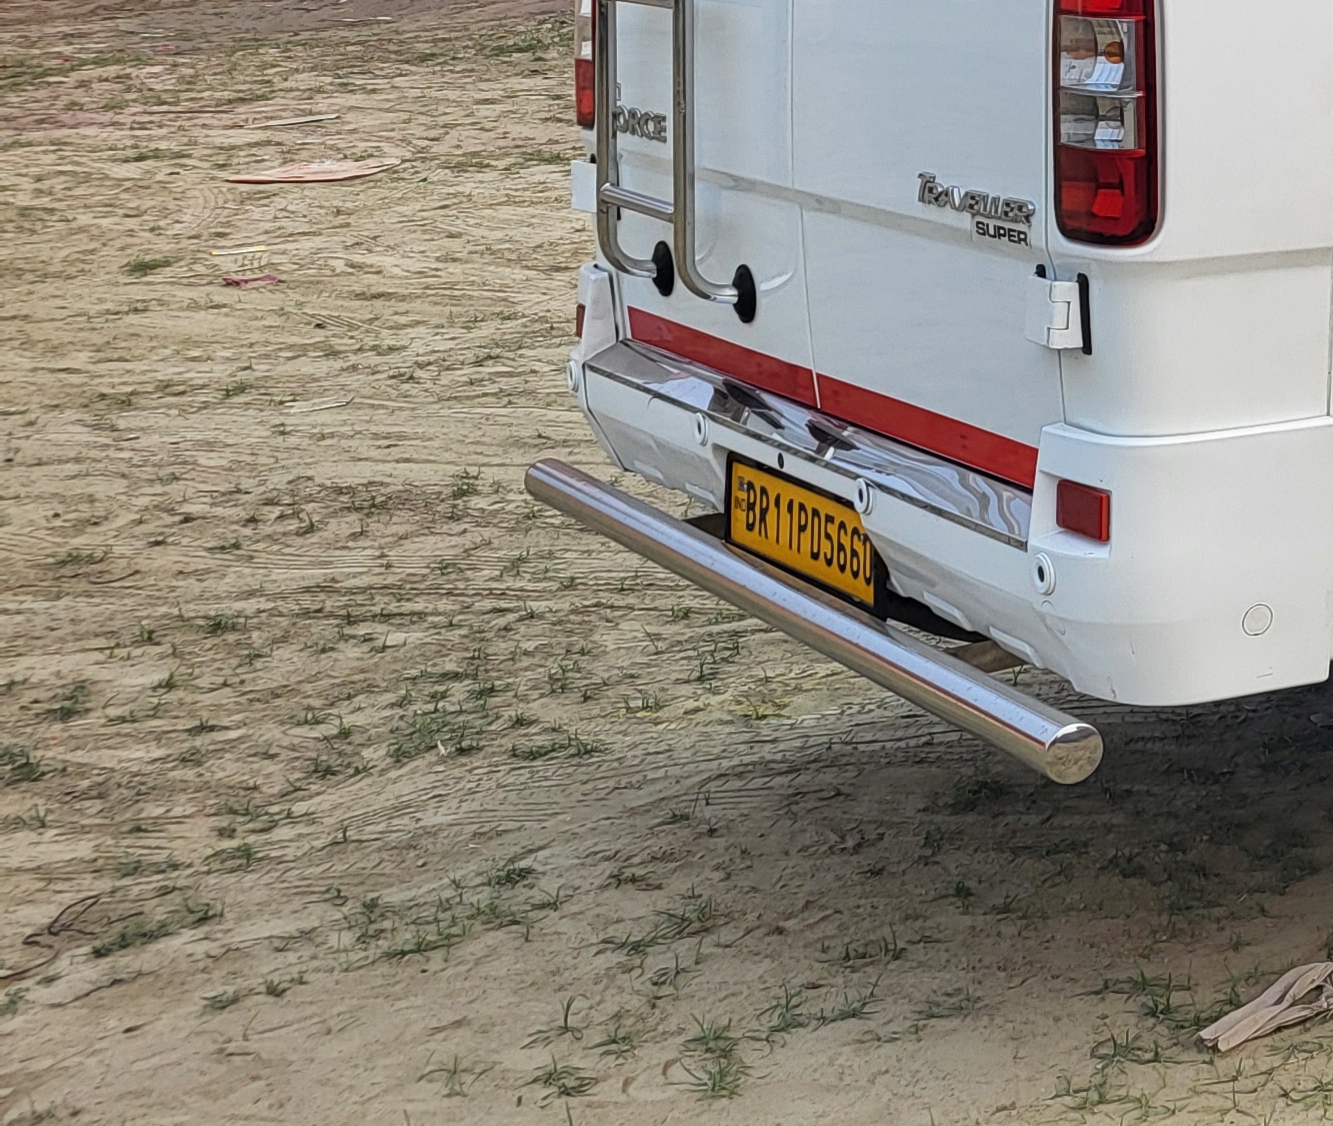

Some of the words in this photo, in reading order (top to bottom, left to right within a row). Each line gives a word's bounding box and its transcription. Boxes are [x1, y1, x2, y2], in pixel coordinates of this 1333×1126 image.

[615, 104, 668, 144] ORCE
[917, 171, 1036, 226] TRAVELLER
[975, 220, 1029, 247] SUPER
[745, 480, 873, 586] BR11PD5660
